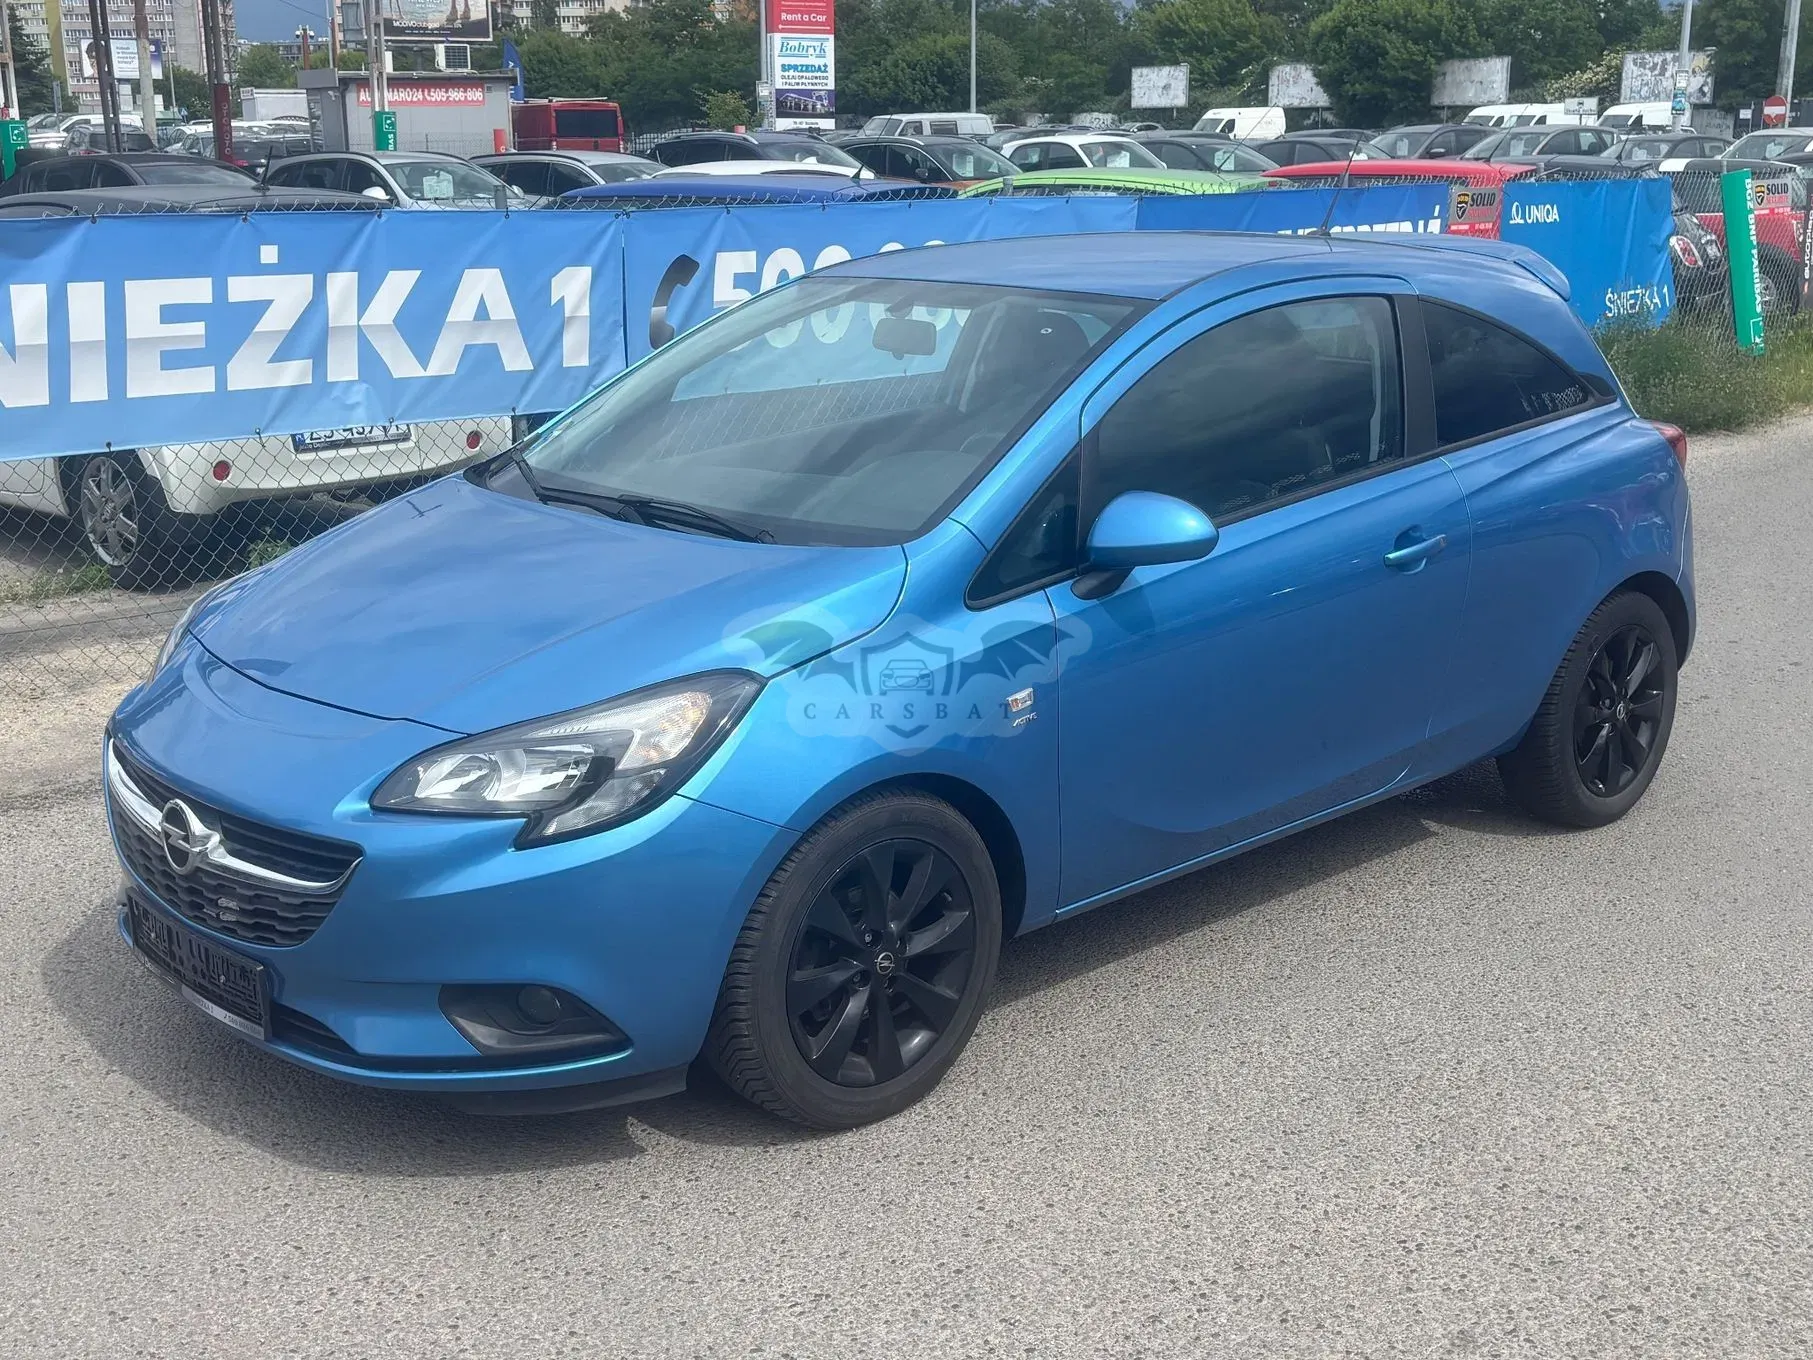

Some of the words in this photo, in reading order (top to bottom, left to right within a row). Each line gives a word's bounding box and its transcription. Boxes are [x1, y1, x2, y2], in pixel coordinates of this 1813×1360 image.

[780, 12, 802, 21] Rent
[810, 13, 828, 22] Car
[779, 41, 828, 57] Bobryk
[780, 62, 829, 74] SPRZEDAŻ
[359, 87, 424, 103] AUMARO24
[429, 87, 484, 102] 505-966-806
[1766, 182, 1789, 196] SOLID
[1470, 192, 1496, 208] SOLID
[1525, 203, 1560, 224] UNIQA
[1747, 213, 1758, 246] BNP
[1751, 248, 1762, 314] PARIBAS
[1604, 284, 1661, 318] ŚNIEŻKA
[1663, 283, 1670, 308] 1
[550, 265, 593, 368] 1
